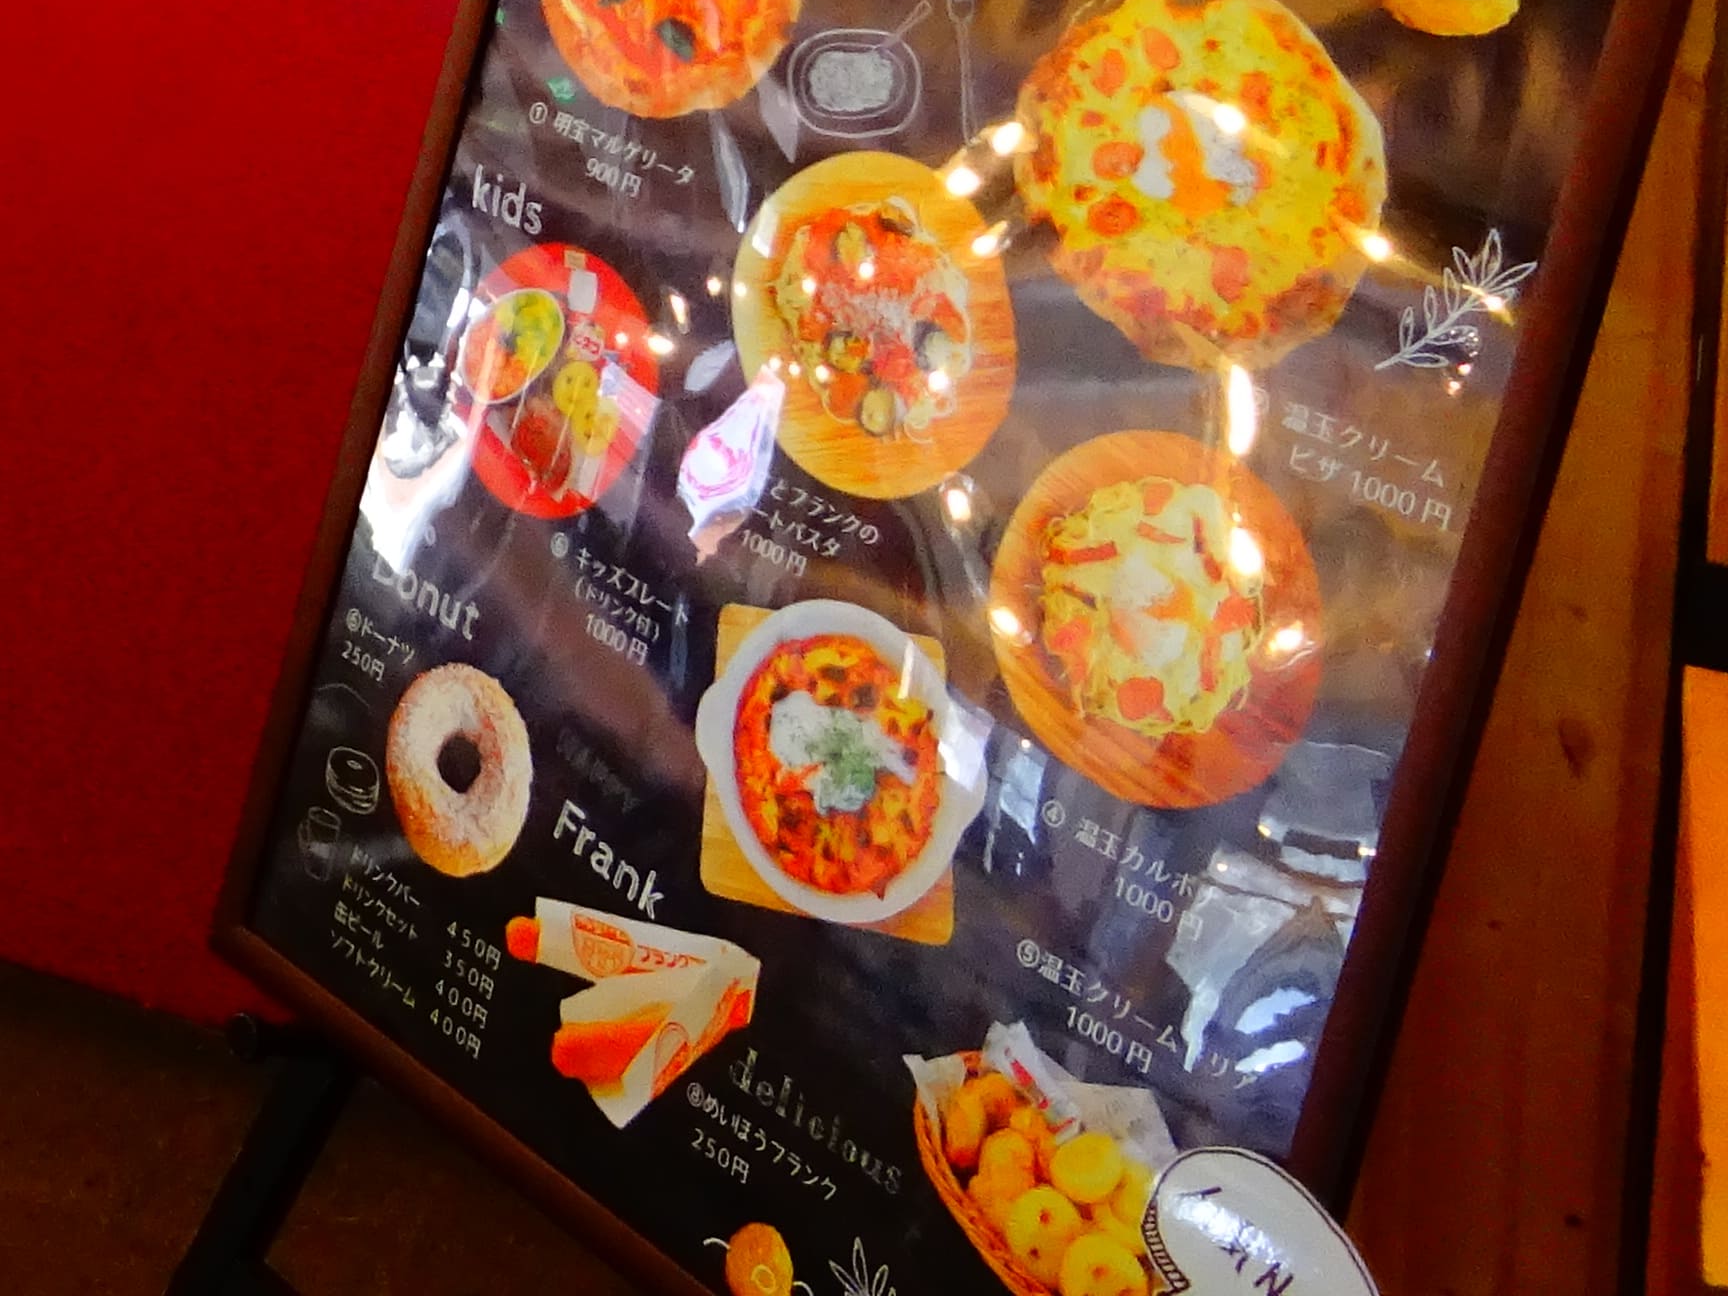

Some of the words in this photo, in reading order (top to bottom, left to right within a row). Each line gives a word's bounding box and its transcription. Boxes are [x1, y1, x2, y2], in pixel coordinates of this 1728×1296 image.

[472, 162, 544, 236] kids
[341, 639, 386, 683] 250円
[349, 844, 421, 907] ドリンクバー
[447, 921, 502, 971] 450円
[552, 798, 666, 920] Frank
[330, 929, 416, 1009] ソフトクリーム
[430, 1008, 482, 1060] 400円
[342, 873, 419, 941] ドリンクセット
[443, 949, 495, 1001] 350円
[435, 979, 489, 1030] 400円
[691, 1126, 750, 1185] 250円
[729, 1047, 902, 1195] delicious
